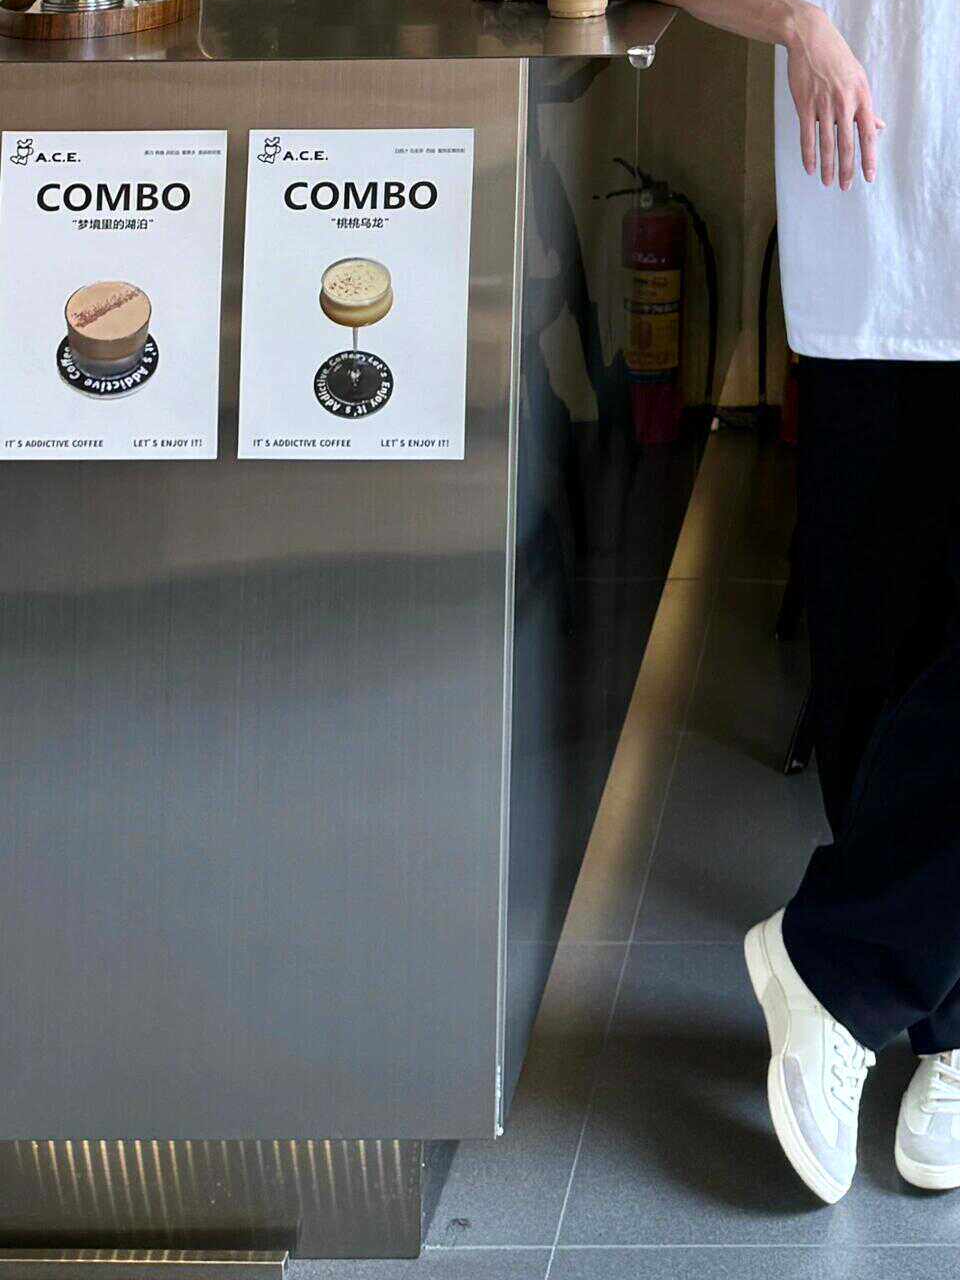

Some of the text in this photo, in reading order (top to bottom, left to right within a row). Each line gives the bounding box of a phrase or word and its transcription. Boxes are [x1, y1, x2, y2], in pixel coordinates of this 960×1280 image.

[35, 152, 81, 163] A.C.E.
[282, 150, 328, 161] A.C.E.
[37, 183, 191, 211] COMBO
[284, 181, 438, 210] COMBO
[83, 365, 149, 392] Addictive
[25, 439, 70, 448] ADDICTIVE
[72, 439, 104, 448] COFFEE
[160, 439, 188, 448] ENJOY
[273, 439, 317, 448] ADDICTIVE
[319, 439, 352, 448] COFFEE
[408, 439, 436, 448] ENJOY
